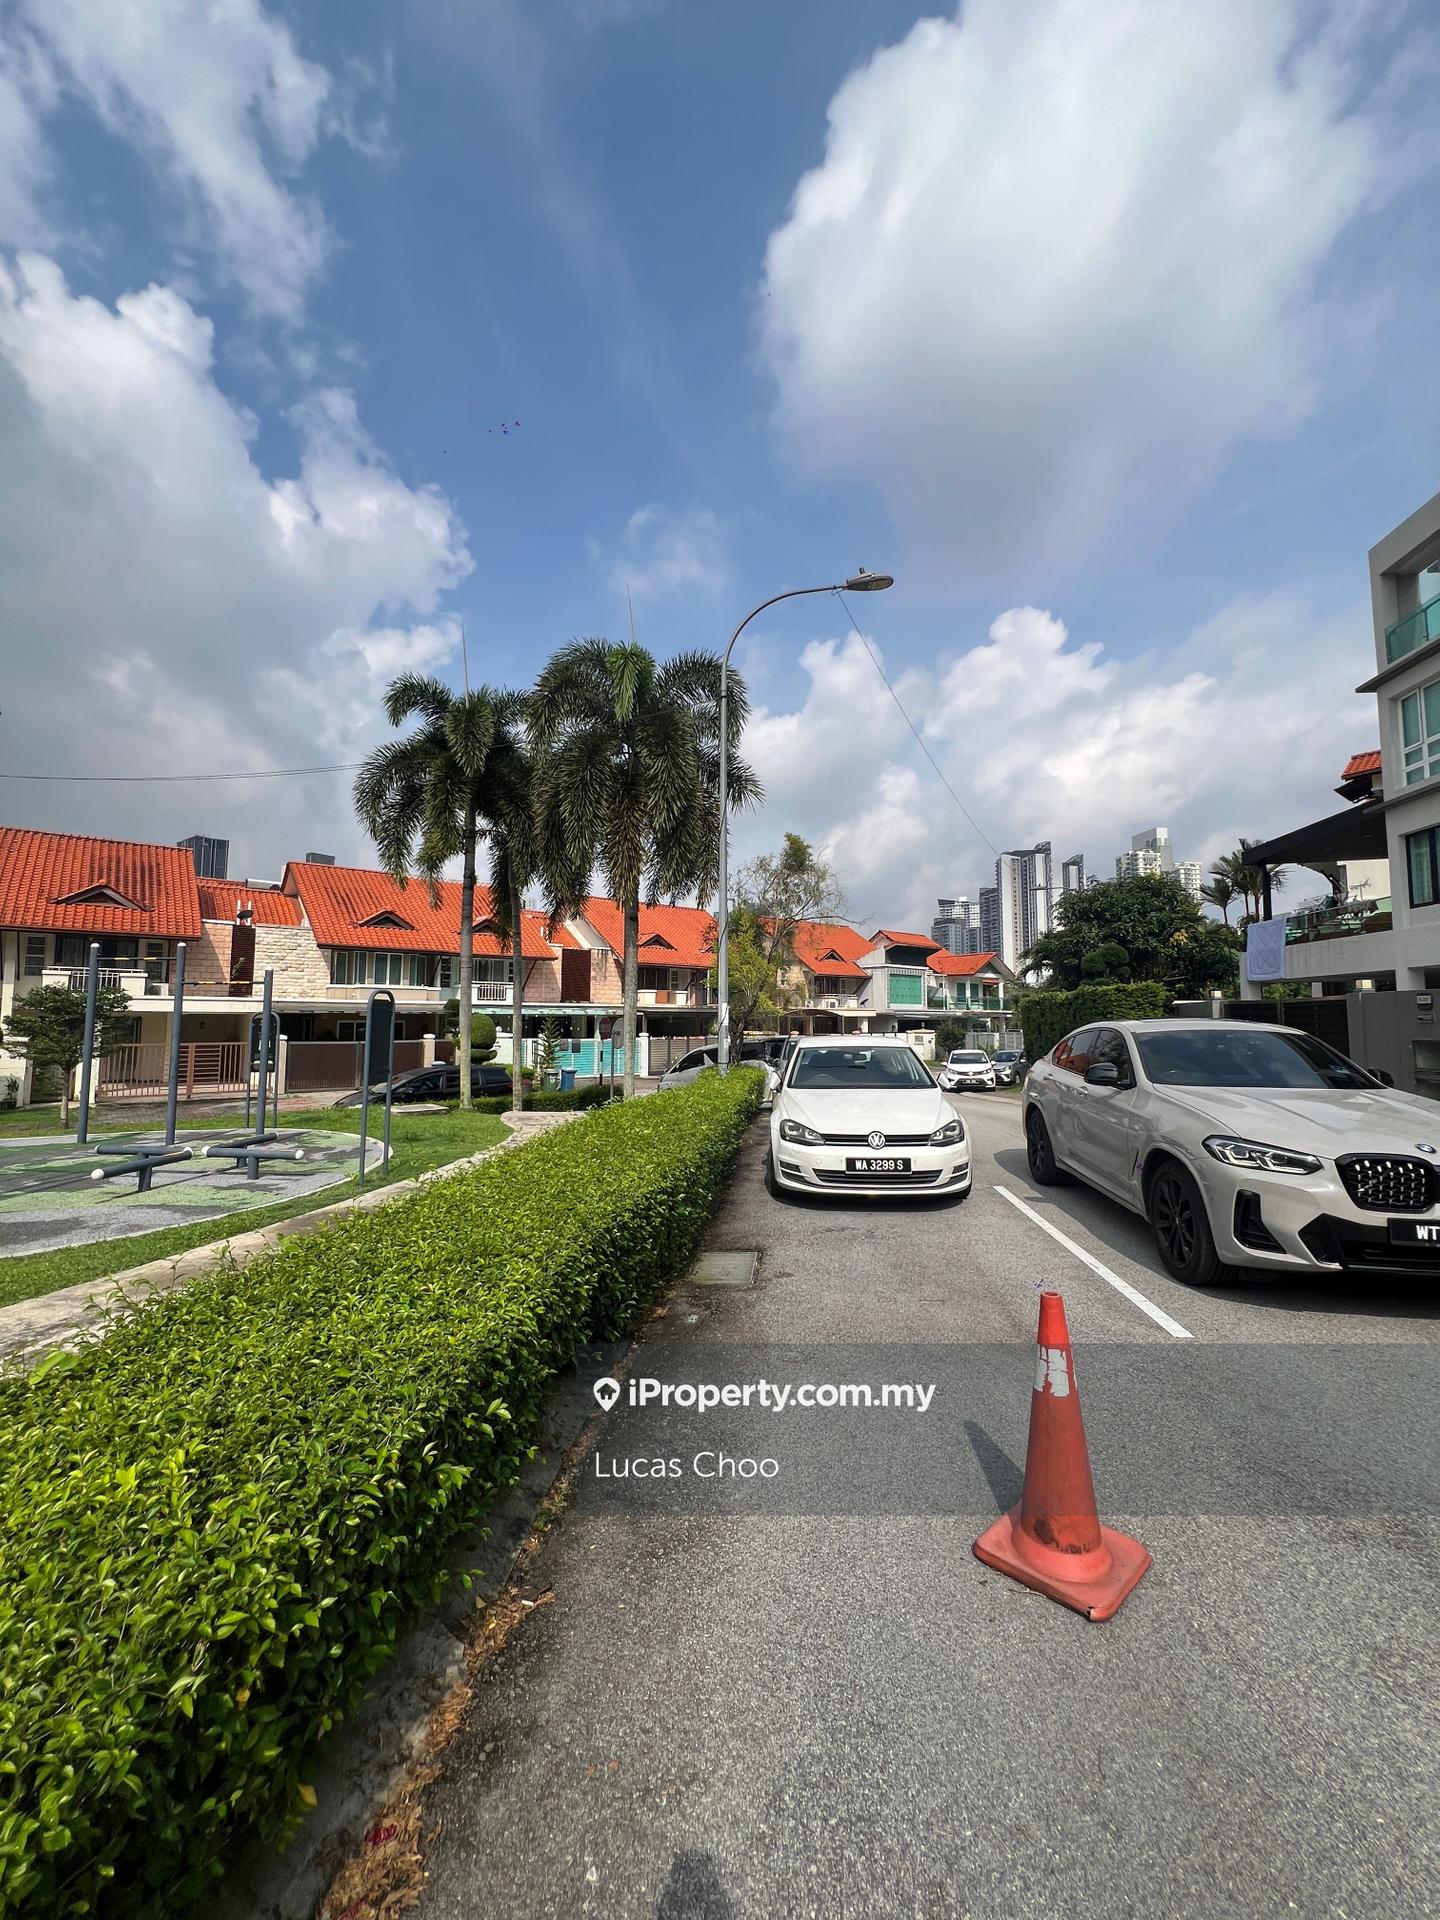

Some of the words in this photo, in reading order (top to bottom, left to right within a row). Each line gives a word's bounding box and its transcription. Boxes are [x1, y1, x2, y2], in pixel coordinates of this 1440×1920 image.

[855, 1159, 868, 1170] WA
[870, 1159, 895, 1170] 3299
[896, 1159, 904, 1170] S
[1415, 1225, 1440, 1240] WT
